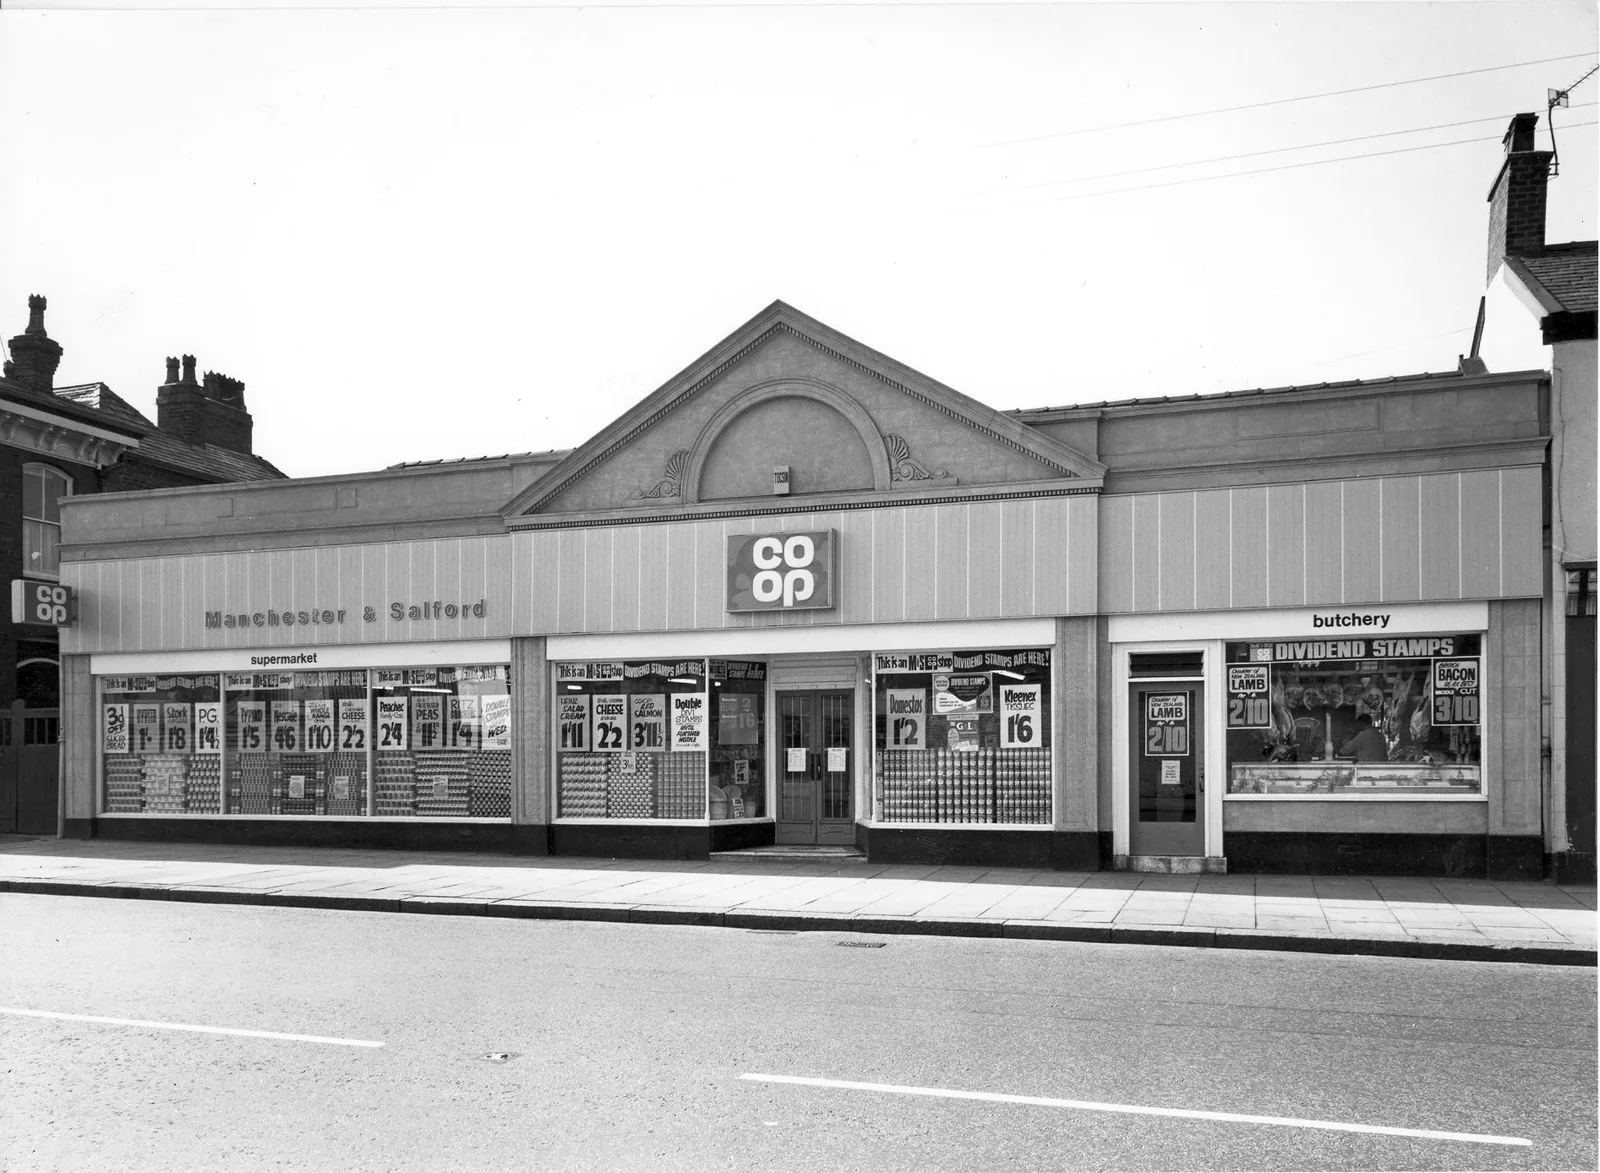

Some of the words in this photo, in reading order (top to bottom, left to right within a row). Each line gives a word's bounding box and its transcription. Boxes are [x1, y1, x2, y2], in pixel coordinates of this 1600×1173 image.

[205, 607, 346, 628] Manchester
[363, 606, 376, 622] &
[390, 599, 487, 622] Salford
[1313, 613, 1391, 628] butchery
[1275, 642, 1366, 660] DIVIDEND
[1373, 638, 1454, 657] STAMPS
[250, 653, 318, 666] supermarket
[878, 655, 890, 670] This
[891, 655, 898, 669] is
[898, 659, 907, 669] an
[938, 655, 952, 669] shop
[953, 654, 983, 669] DIVIDEND
[984, 652, 1012, 667] STAMPS
[1013, 652, 1027, 666] ARE
[1028, 650, 1050, 666] HERE!
[559, 665, 571, 678] This
[624, 664, 650, 678] DIVIDEND
[651, 662, 675, 677] STAMPS
[675, 662, 687, 676] ARE
[1438, 667, 1476, 682] BACON
[1232, 679, 1266, 691] LAMB
[1004, 689, 1037, 702] Kleenex
[450, 699, 475, 711] RITZ
[563, 705, 585, 713] SALAD
[596, 704, 624, 715] CHEESE
[675, 698, 702, 710] Double
[889, 693, 923, 714] Domestos
[1006, 702, 1035, 711] TISSUES
[1435, 695, 1478, 723] 3/10
[341, 711, 366, 720] CHEESE
[416, 709, 439, 720] PEAS
[634, 709, 663, 718] SALMON
[1151, 707, 1184, 719] LAMB
[1229, 698, 1269, 725] 2/10
[675, 715, 703, 723] STAMPS
[1148, 726, 1186, 753] 2/10
